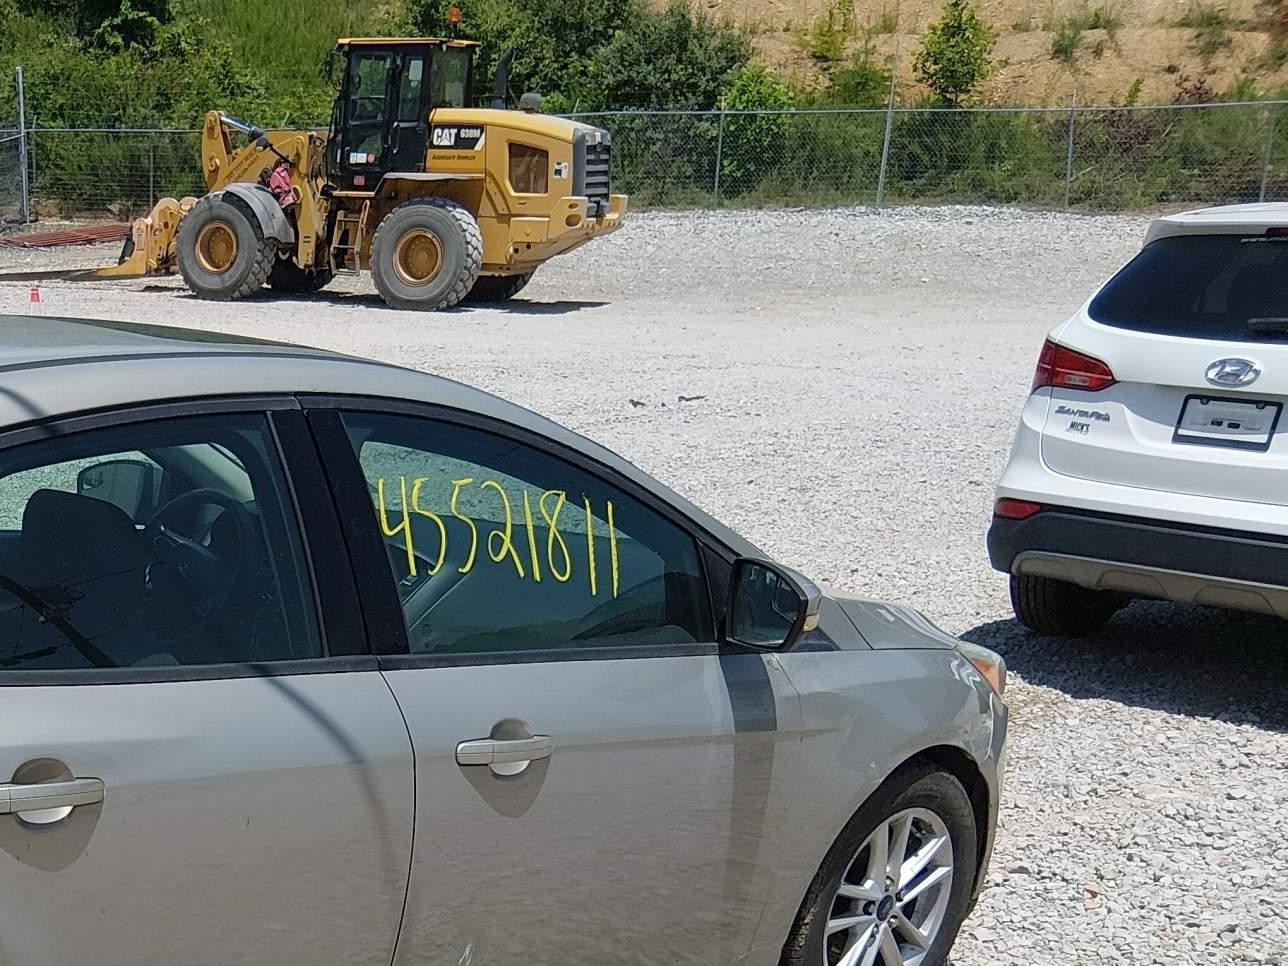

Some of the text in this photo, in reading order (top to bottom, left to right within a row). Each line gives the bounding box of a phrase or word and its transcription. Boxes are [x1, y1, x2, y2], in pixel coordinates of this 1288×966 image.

[432, 128, 481, 146] CAT 938M
[378, 477, 619, 599] 45521811
